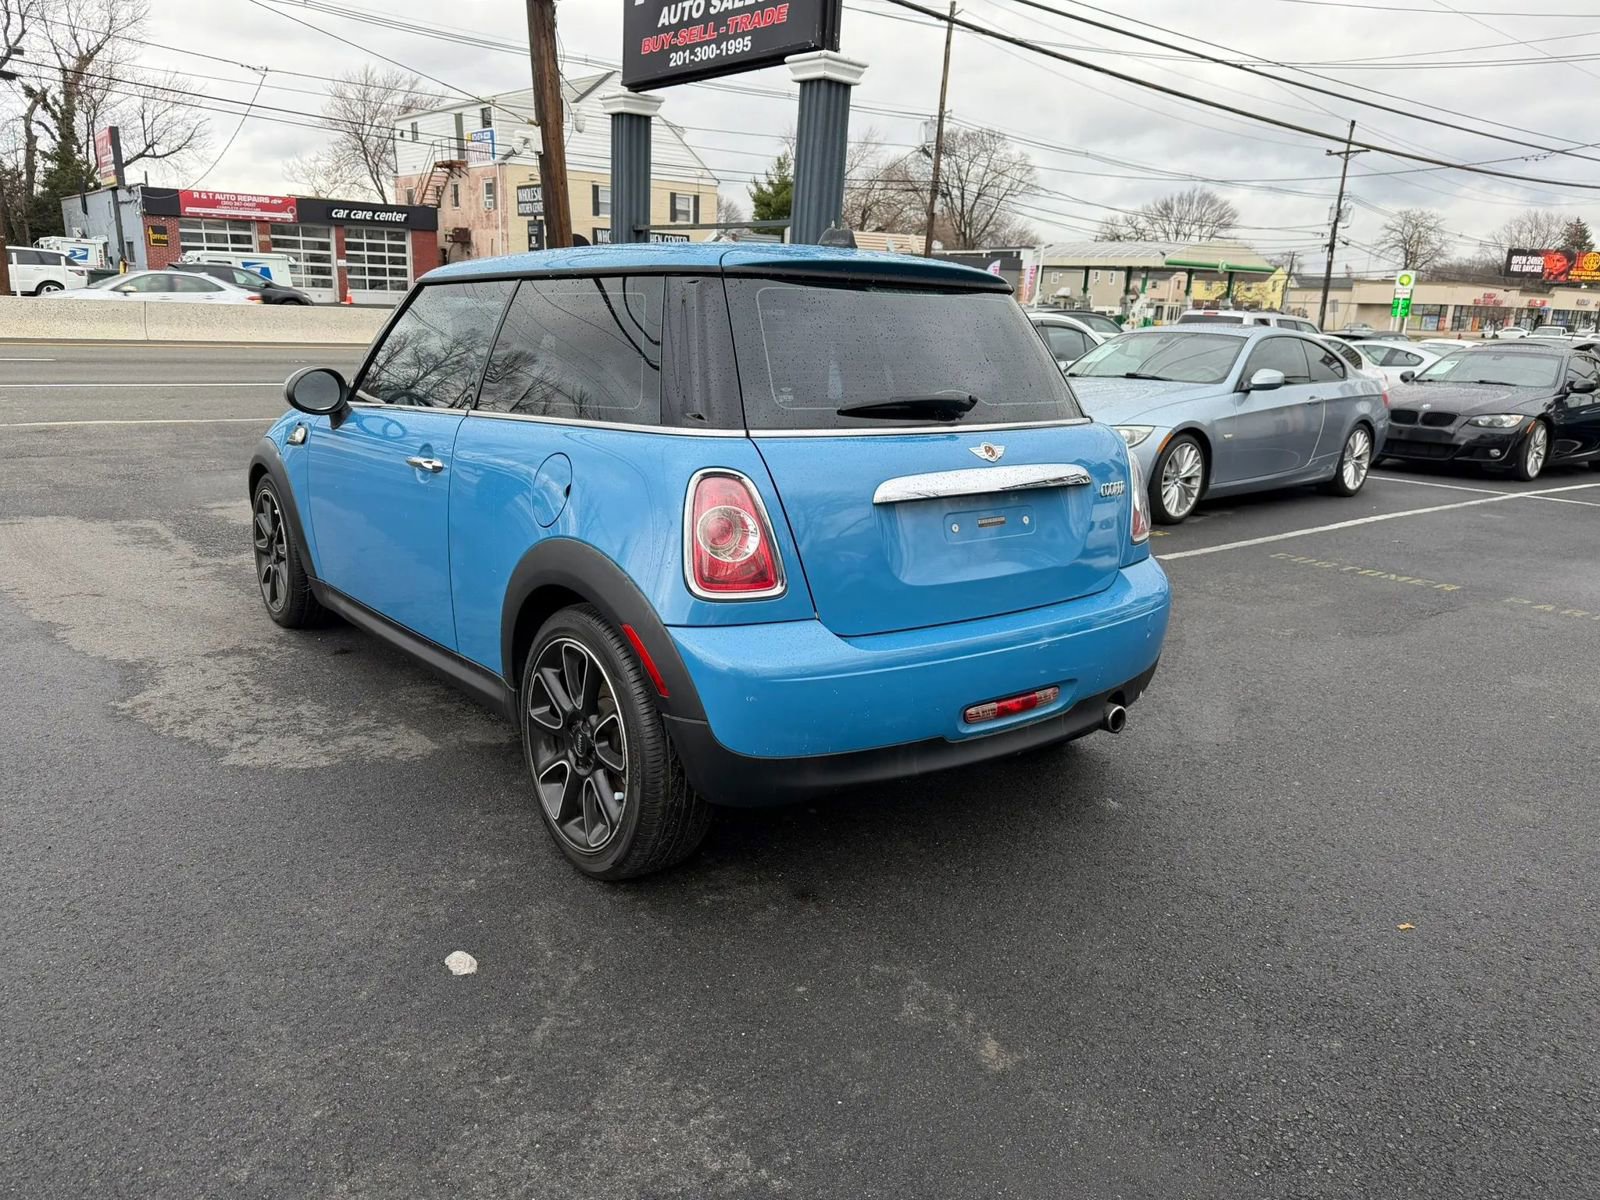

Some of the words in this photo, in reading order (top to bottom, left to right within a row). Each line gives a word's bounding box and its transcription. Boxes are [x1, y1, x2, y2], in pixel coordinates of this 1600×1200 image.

[657, 0, 705, 27] AUTO
[669, 36, 752, 67] 201-300-1995
[193, 191, 200, 199] R
[215, 193, 236, 201] AUTO
[237, 195, 270, 204] REPAIRS
[332, 208, 349, 219] car
[350, 209, 373, 220] care
[374, 211, 408, 222] center
[152, 233, 169, 241] OFFICE
[1511, 255, 1527, 265] OPEN
[1510, 264, 1521, 272] FREE
[1522, 265, 1543, 273] DAYCARE
